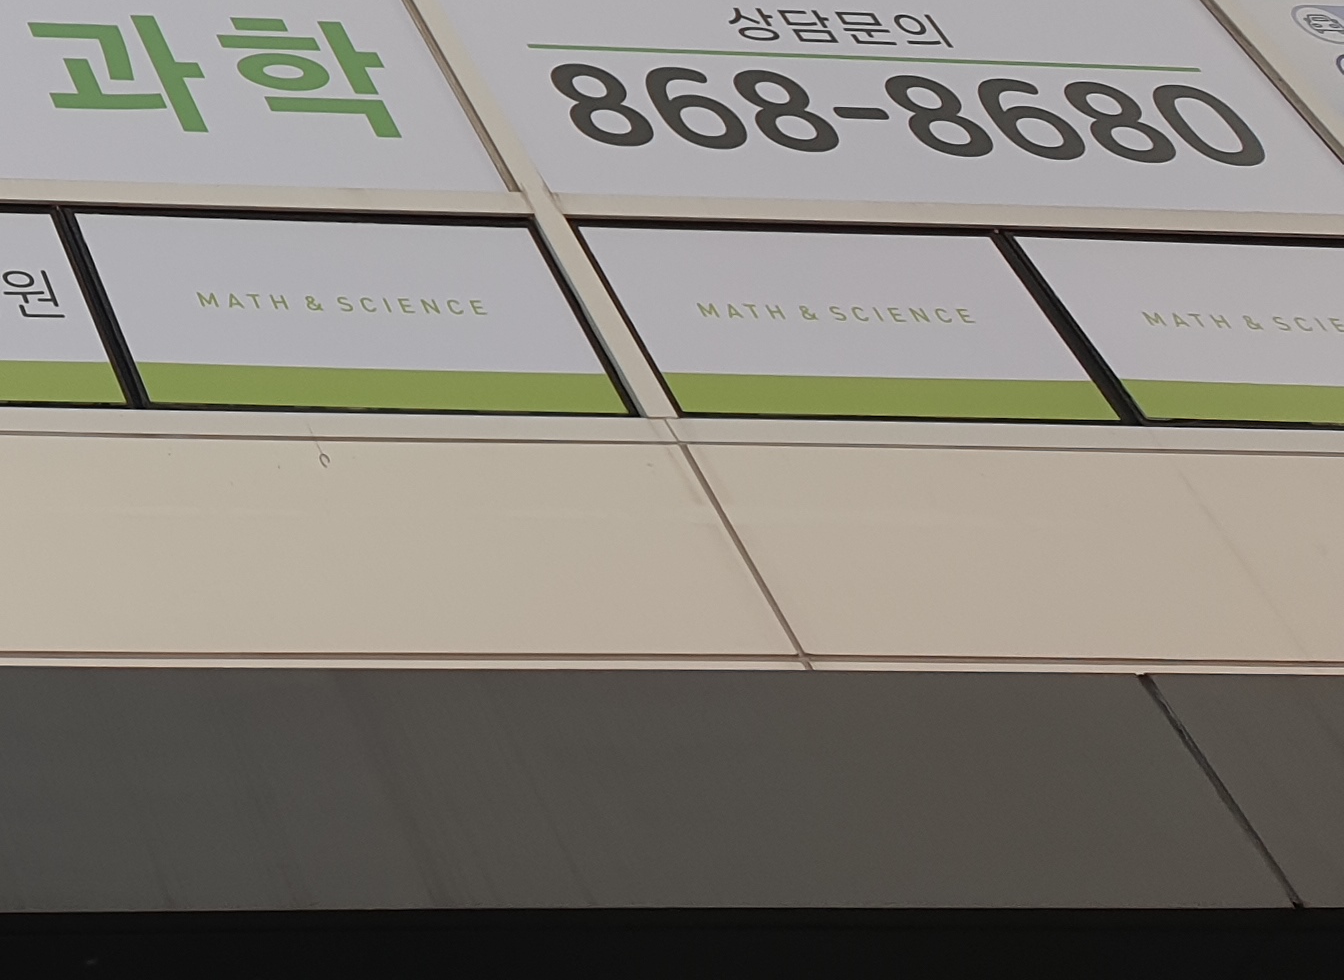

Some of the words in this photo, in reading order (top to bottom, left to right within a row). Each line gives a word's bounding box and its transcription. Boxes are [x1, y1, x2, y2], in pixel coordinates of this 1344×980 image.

[728, 7, 953, 49] 상담문의
[27, 14, 403, 139] 과학
[549, 62, 1267, 167] 868-8680
[196, 291, 289, 310] MATH
[304, 295, 324, 312] &
[336, 296, 488, 316] SCIENCE
[696, 302, 786, 320] MATH
[798, 305, 818, 321] &
[828, 305, 976, 324] SCIENCE
[1141, 311, 1232, 329] MATH
[1242, 314, 1264, 331] &
